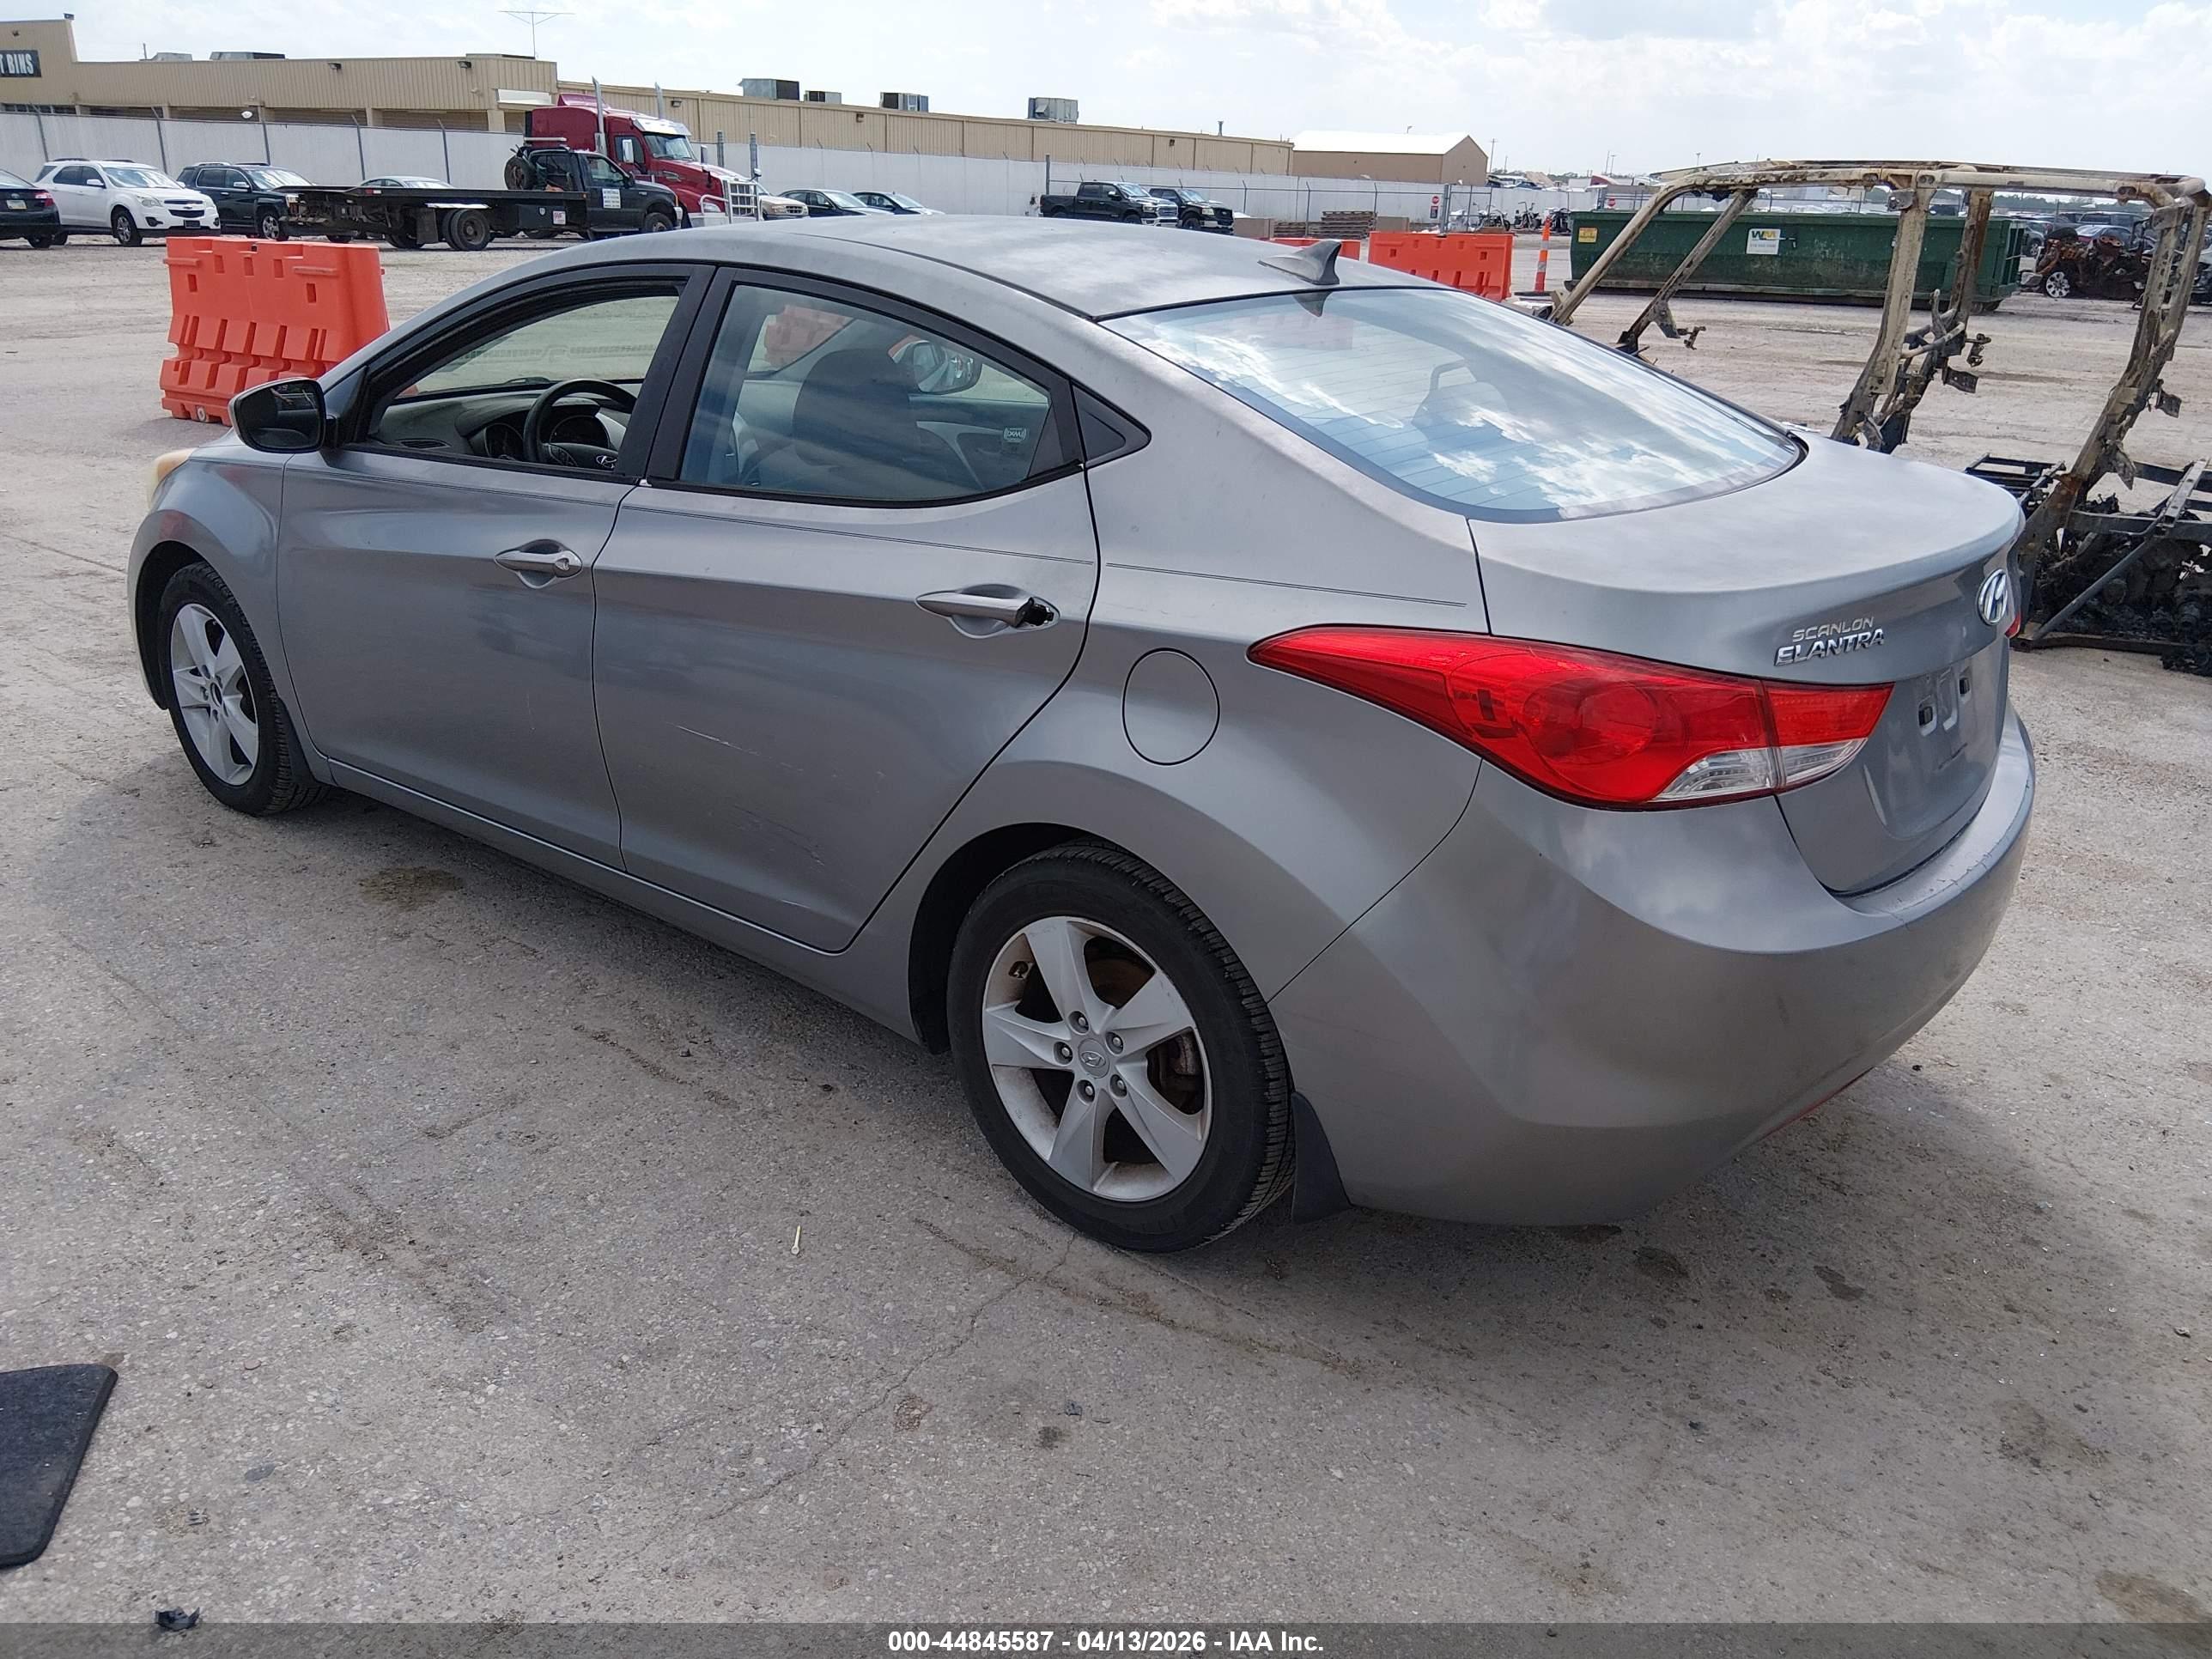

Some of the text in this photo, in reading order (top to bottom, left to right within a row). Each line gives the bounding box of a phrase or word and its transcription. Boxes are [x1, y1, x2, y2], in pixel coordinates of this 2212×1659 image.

[6, 53, 33, 74] BINS
[1791, 616, 1875, 643] SCANLON
[1774, 628, 1885, 666] ELANTRA
